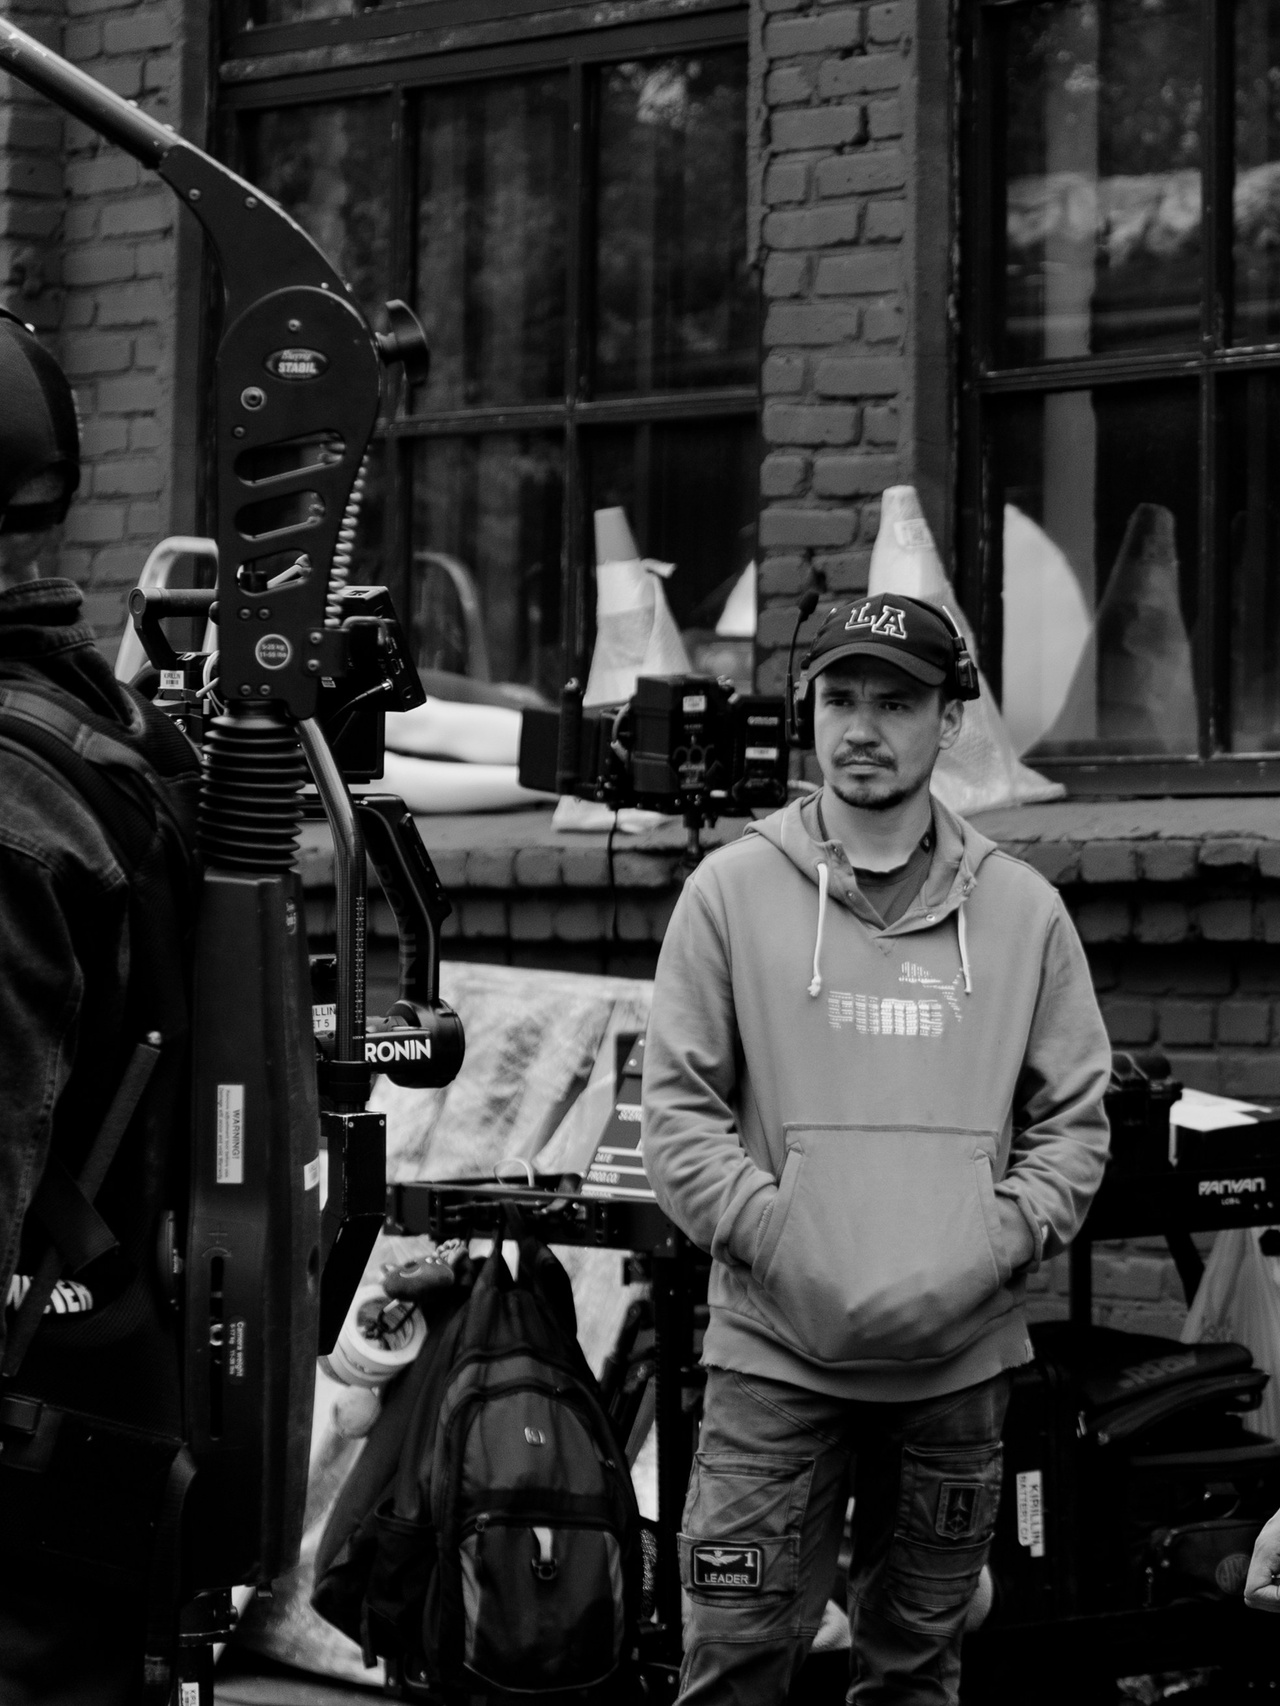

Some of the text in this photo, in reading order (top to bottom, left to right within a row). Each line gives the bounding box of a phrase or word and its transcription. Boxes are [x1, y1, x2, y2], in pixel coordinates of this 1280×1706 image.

[845, 602, 907, 639] LA
[365, 1039, 431, 1063] RONIN
[232, 1109, 240, 1159] WARNING!
[744, 1552, 755, 1567] 1
[704, 1573, 749, 1584] LEADER
